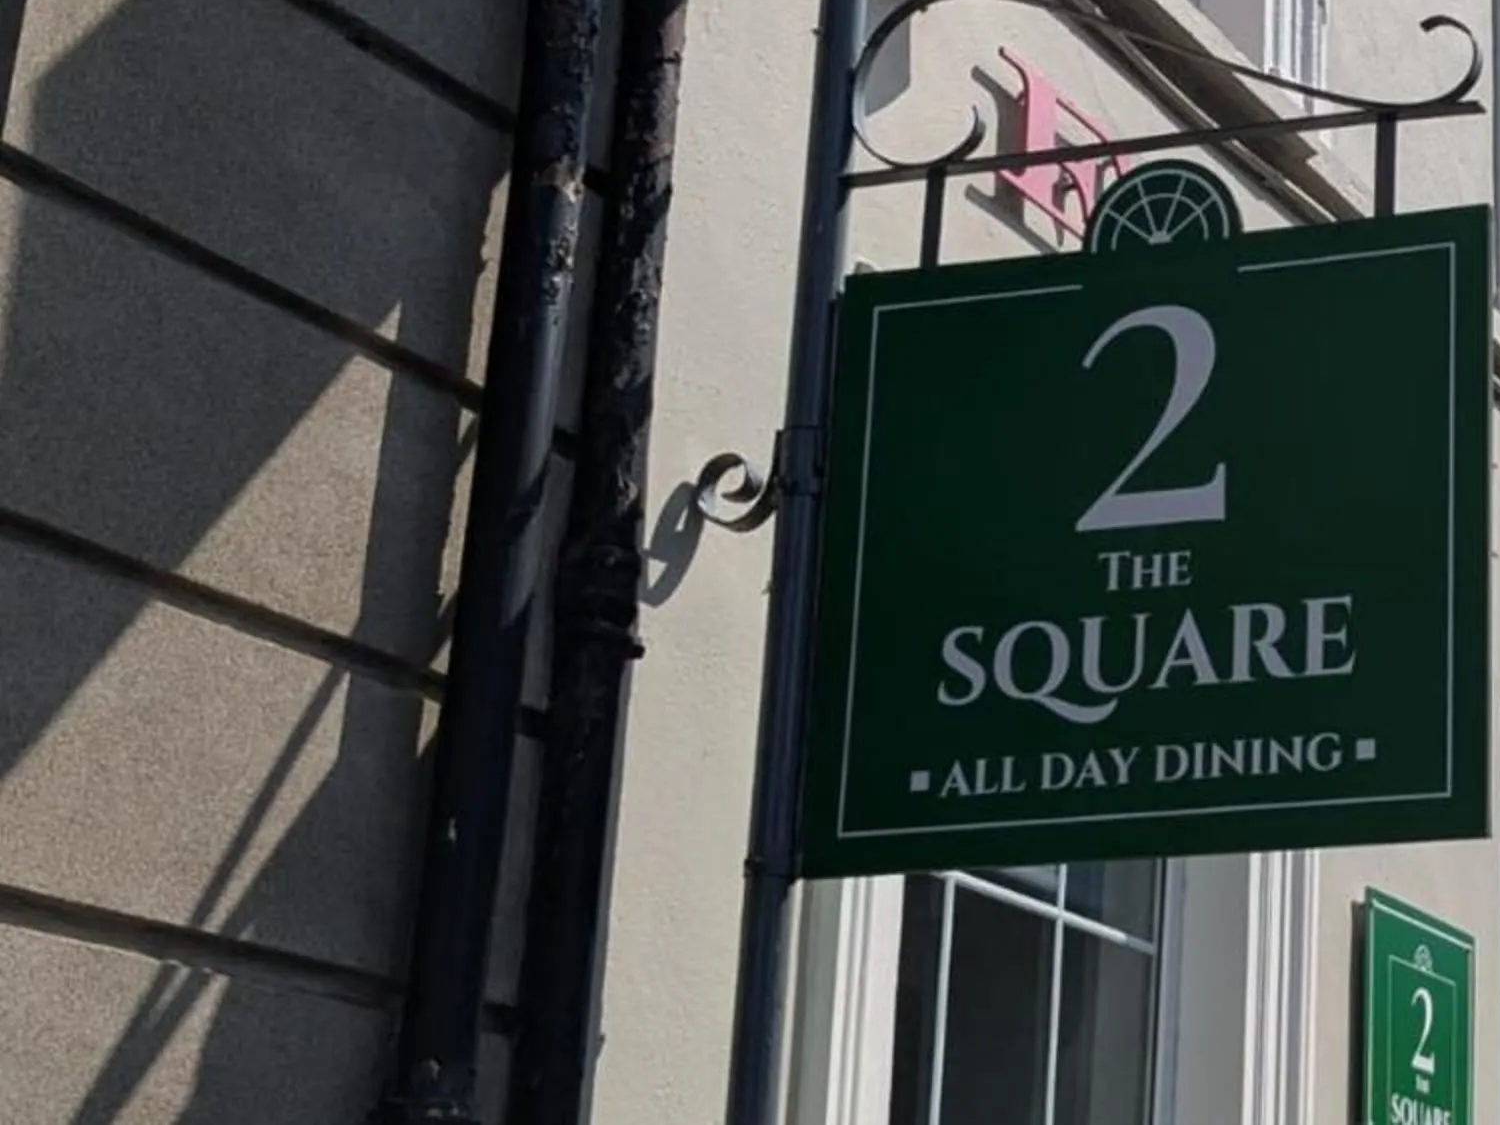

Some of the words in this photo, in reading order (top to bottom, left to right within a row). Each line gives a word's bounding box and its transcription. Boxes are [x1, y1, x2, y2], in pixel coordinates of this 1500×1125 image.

[1075, 305, 1226, 532] 2
[1099, 550, 1192, 593] THE
[937, 595, 1356, 724] SQUARE
[938, 756, 1026, 799] ALL
[1040, 745, 1140, 792] DAY
[1154, 732, 1343, 784] DINING
[1411, 986, 1435, 1075] 2
